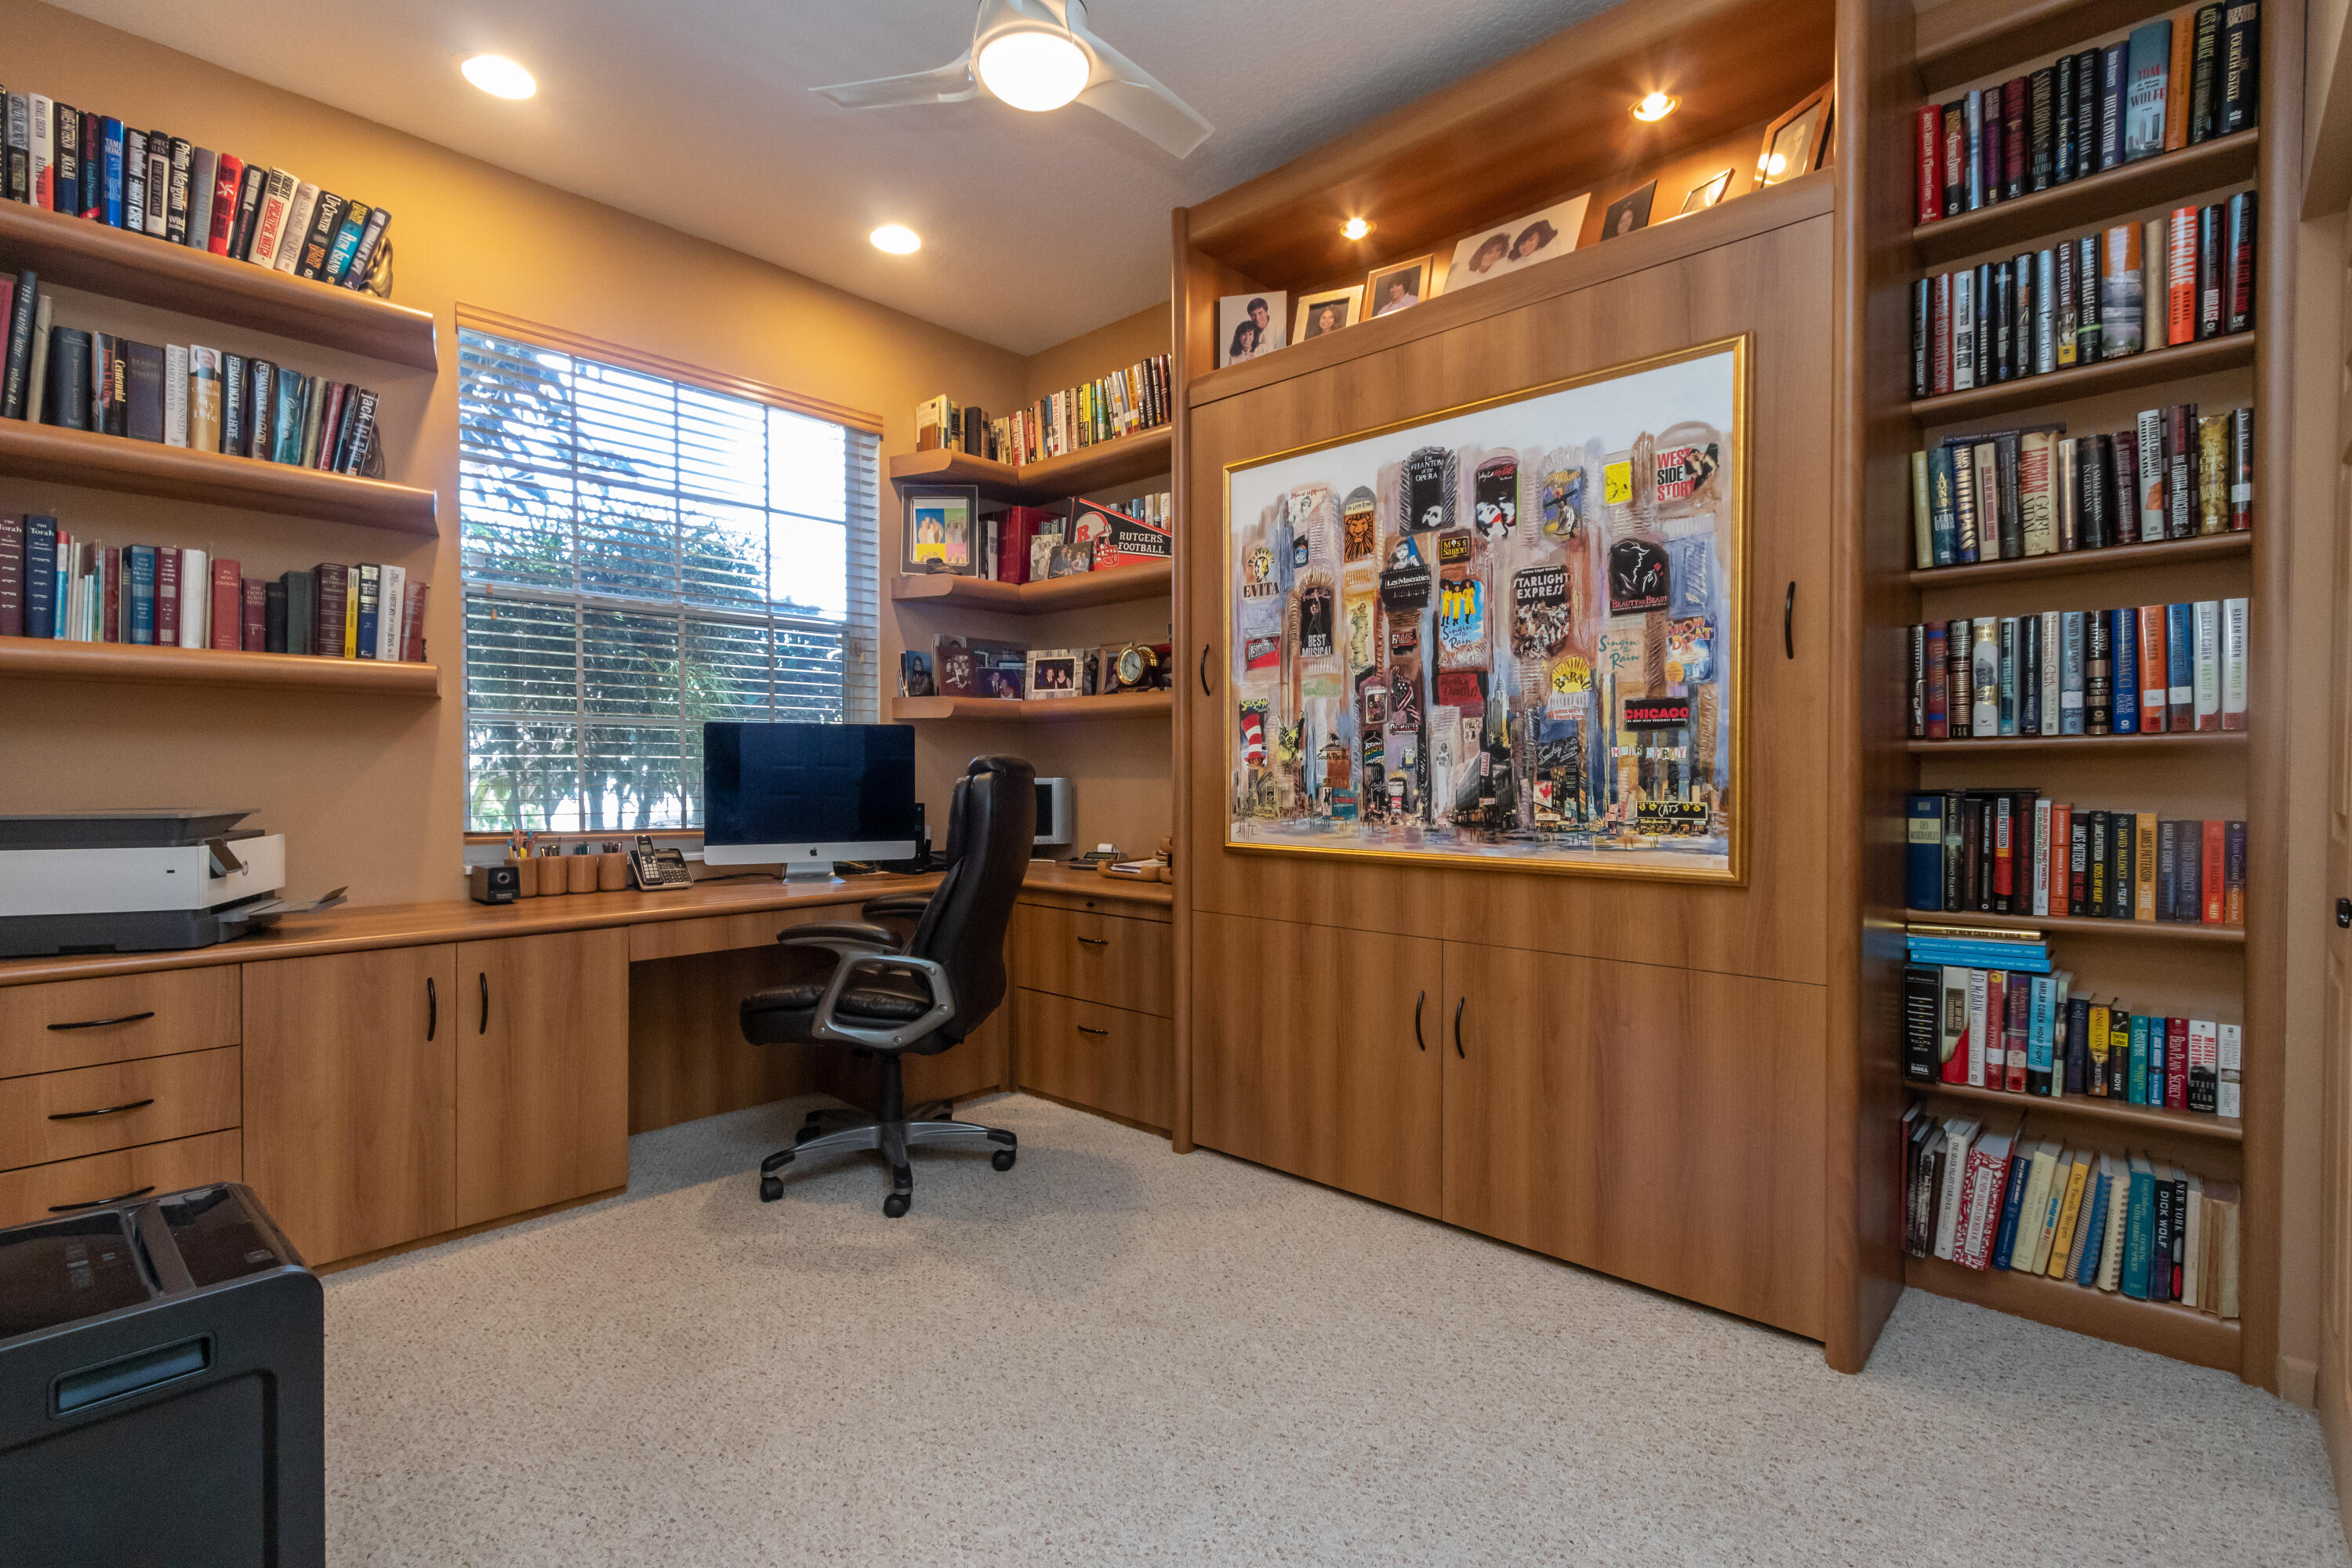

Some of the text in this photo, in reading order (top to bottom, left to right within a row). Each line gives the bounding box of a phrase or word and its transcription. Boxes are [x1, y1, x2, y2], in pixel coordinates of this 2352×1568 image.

[2197, 8, 2217, 61] ACTS OF MALICE
[2228, 31, 2242, 71] FOURTH
[2227, 71, 2241, 102] ESTATE
[2033, 71, 2051, 144] SANDRA BROWN
[2103, 94, 2117, 120] TOTAL
[2059, 119, 2068, 168] JOHN GRISHAM
[170, 140, 191, 212] Phillip Margolin
[267, 170, 283, 196] LUDLUM
[280, 175, 294, 201] ROBERT
[257, 198, 282, 258] APOCALYPSE WATCH
[326, 249, 350, 274] ISLAND
[2170, 215, 2195, 289] AIRFRAME
[2060, 243, 2071, 307] LISA SCOTTOLINE
[2082, 278, 2095, 304] BULLET
[2203, 289, 2219, 322] MIRAGE
[9, 285, 31, 393] 1958 scarlet letter volume
[1935, 318, 1949, 389] RED PATTERSON
[114, 359, 126, 402] Centennial
[257, 364, 270, 412] HERMAN WOUK
[227, 356, 240, 439] HERMAN WOUK HOPE
[1657, 447, 1692, 469] WEST
[2148, 416, 2161, 477] PATRICIA CORNWELL
[1415, 474, 1438, 482] OPERA
[1657, 466, 1682, 486] SIDE
[2021, 447, 2049, 494] LINCOLN
[1657, 478, 1695, 502] STORY
[2082, 464, 2092, 513] IN GERMANY
[2092, 470, 2102, 521] SMALL TOWN
[2172, 464, 2187, 525] FOURTH PROCEDURE
[1955, 470, 1976, 549] MITLA PASS
[2023, 497, 2035, 534] VIDAL
[2034, 495, 2050, 538] GORE
[30, 527, 54, 536] Torah
[1077, 524, 1090, 541] R
[1120, 532, 1163, 544] RUTGERS
[1118, 543, 1164, 554] FOOTBALL
[1243, 582, 1279, 598] EVITA
[1513, 572, 1570, 588] STARLIGHT
[1517, 583, 1565, 599] EXPRESS
[1612, 599, 1639, 608] BEAUTY
[1646, 595, 1668, 604] BEAST
[1301, 646, 1333, 656] MUSICAL
[1308, 633, 1327, 648] BEST
[1450, 638, 1472, 650] Rain
[2068, 615, 2079, 673] DAVID BALDACCI
[2089, 622, 2100, 659] BALDACCI
[2098, 629, 2107, 651] DAVID
[2201, 612, 2212, 690] HARLAN COBEN PROMISE
[2231, 608, 2242, 688] HARLAN COBEN PROMISE
[1609, 652, 1639, 670] Rain
[2117, 643, 2132, 688] BALDACCI
[1976, 668, 1985, 701] ASSASSIN
[1624, 707, 1689, 720] CHICAGO
[2116, 693, 2125, 714] GAME
[2125, 695, 2134, 714] HOUR
[1538, 743, 1562, 765] Smokey
[1658, 804, 1679, 817] CATS
[1998, 798, 2009, 848] JAMES PATTERSON
[2117, 828, 2128, 879] DAVID BALDACCI
[2162, 823, 2173, 873] HARLAN COBEN
[2233, 838, 2242, 853] JOHN
[2071, 824, 2087, 902] JAMES PATTERSON THE CHEF
[2092, 823, 2104, 903] JAMES PATTERSON CROSS MY HEART
[2140, 828, 2151, 909] JAMES PATTERSON STORE
[2181, 842, 2195, 891] DAVID BALDACCI
[1971, 974, 1984, 1011] ED McBAIN
[2010, 991, 2019, 1014] Parker
[2038, 982, 2046, 1003] HARLAN
[2153, 1036, 2162, 1047] JACK
[2190, 1035, 2201, 1065] CRICHTON
[2204, 1036, 2215, 1064] MICHAEL
[2169, 1052, 2184, 1098] PLAIN SECRECY
[1944, 1185, 1953, 1212] COOKBOOK
[1979, 1170, 1990, 1195] THE NEW
[2060, 1173, 2082, 1239] Our Favorite Recipes
[2158, 1190, 2169, 1248] DICK WOLF
[2173, 1182, 2186, 1232] NEW YORK
[2132, 1221, 2140, 1242] HERBS
